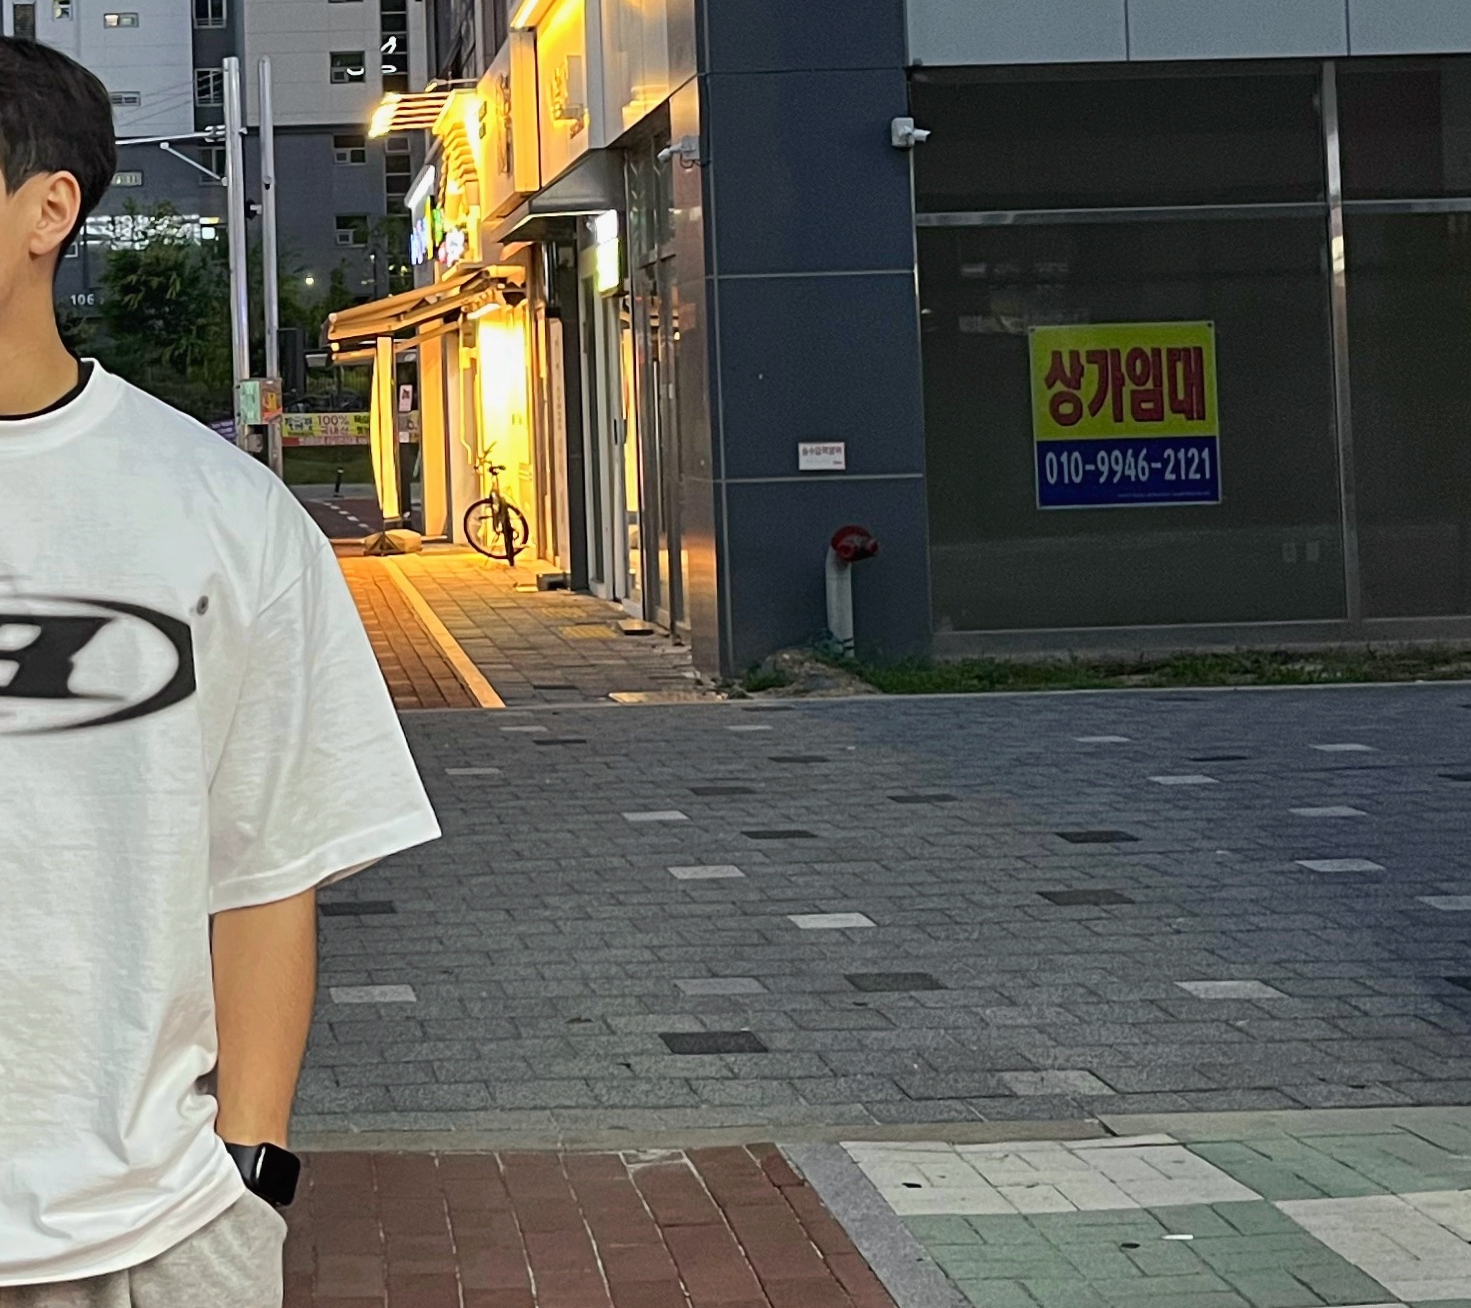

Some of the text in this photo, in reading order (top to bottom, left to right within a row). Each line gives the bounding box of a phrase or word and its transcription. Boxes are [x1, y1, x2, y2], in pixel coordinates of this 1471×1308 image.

[70, 293, 95, 306] 106
[1044, 346, 1206, 427] 상가임대
[317, 415, 350, 426] 100%
[1045, 447, 1211, 485] 010-9946-2121
